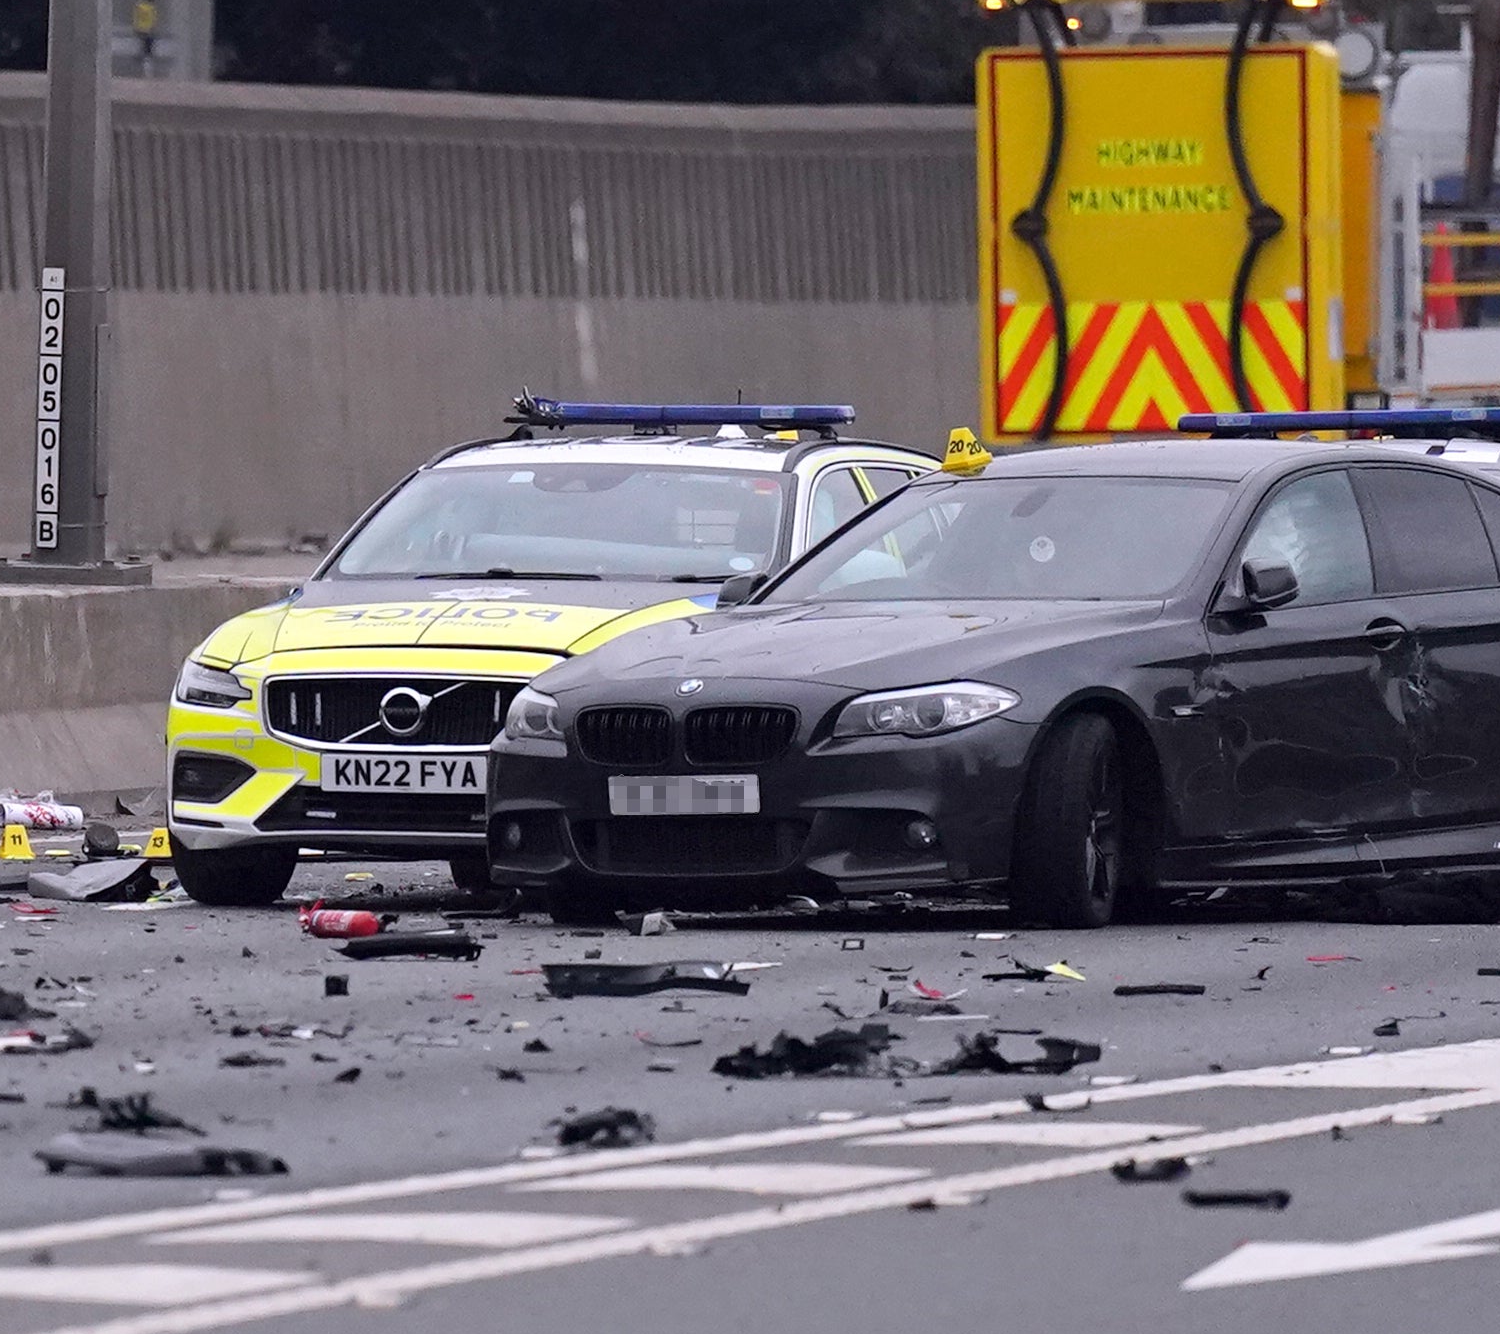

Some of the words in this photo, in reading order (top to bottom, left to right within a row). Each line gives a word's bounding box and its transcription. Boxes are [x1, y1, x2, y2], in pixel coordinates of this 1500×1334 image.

[1097, 138, 1203, 167] HIGHWAY
[1067, 185, 1232, 213] MAINTENANCE
[949, 439, 965, 454] 20
[334, 758, 411, 787] KN22
[419, 760, 478, 788] FYA
[11, 834, 22, 846] 11
